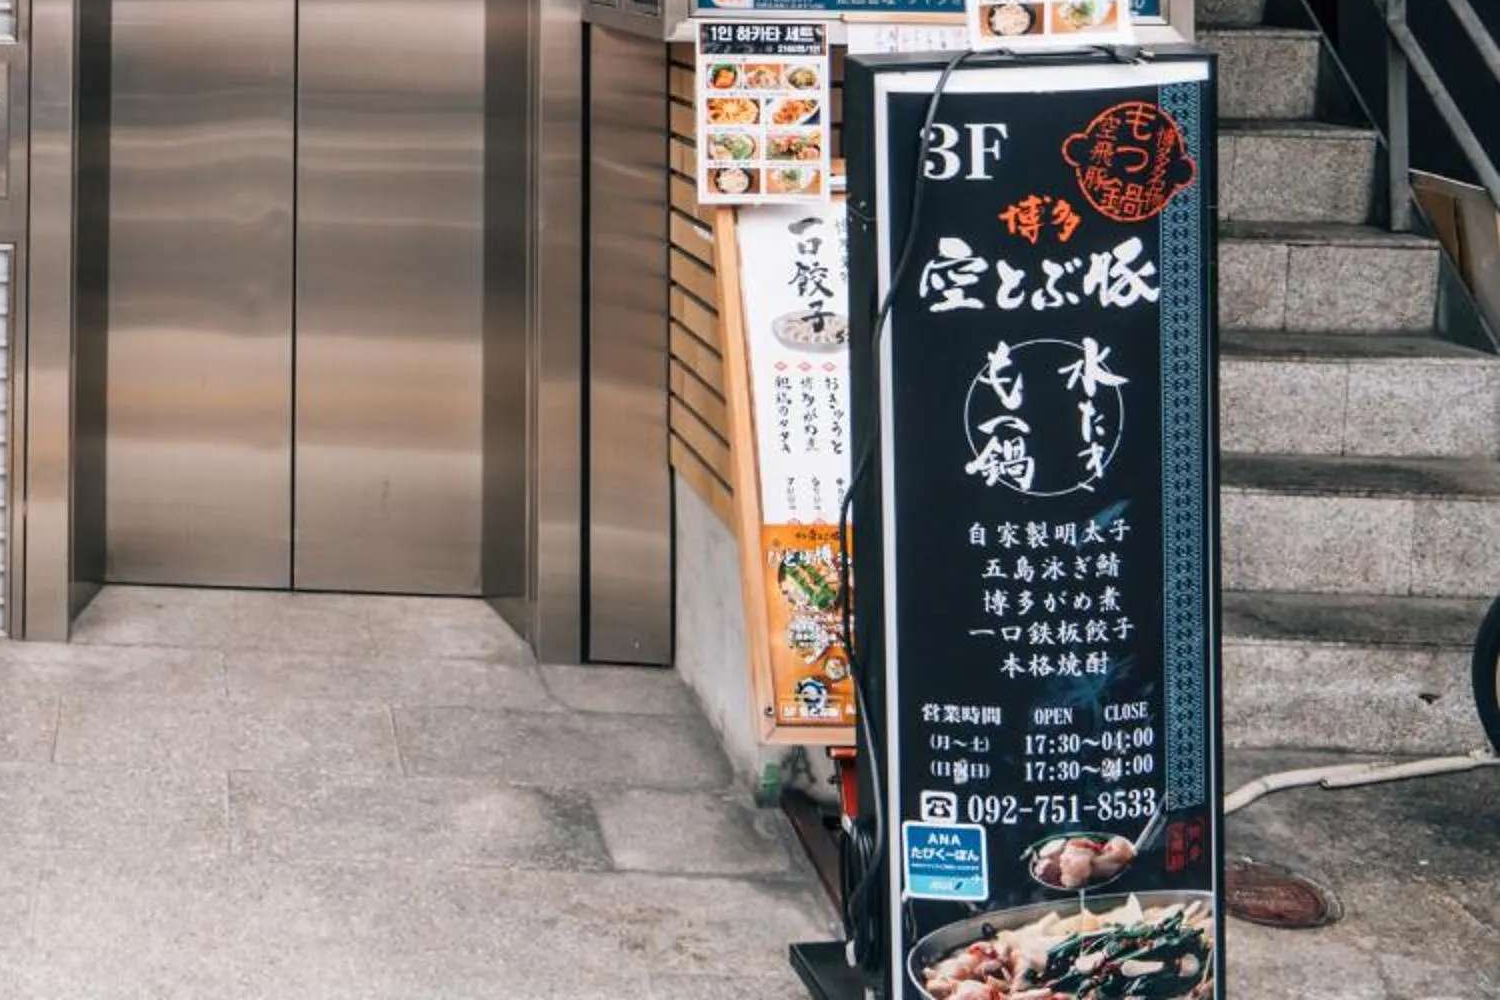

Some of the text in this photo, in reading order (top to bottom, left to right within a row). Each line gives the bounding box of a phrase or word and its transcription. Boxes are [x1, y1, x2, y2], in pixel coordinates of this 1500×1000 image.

[710, 25, 732, 41] 1인
[784, 25, 816, 42] 세트
[919, 123, 1008, 180] 3F
[998, 194, 1081, 245] 博多
[788, 216, 835, 334] 一口餃子
[919, 237, 1160, 313] 空とぶ豚
[968, 519, 1131, 548] 自家製明太子
[983, 586, 1121, 616] 博多がめ煮
[968, 616, 1134, 645] 一口鉄板餃子
[1000, 651, 1110, 679] 本格焼酎
[921, 702, 1149, 725] 営業時間 OPEN CLOSE
[967, 787, 1156, 826] 092-751-8533
[927, 833, 961, 846] ANA
